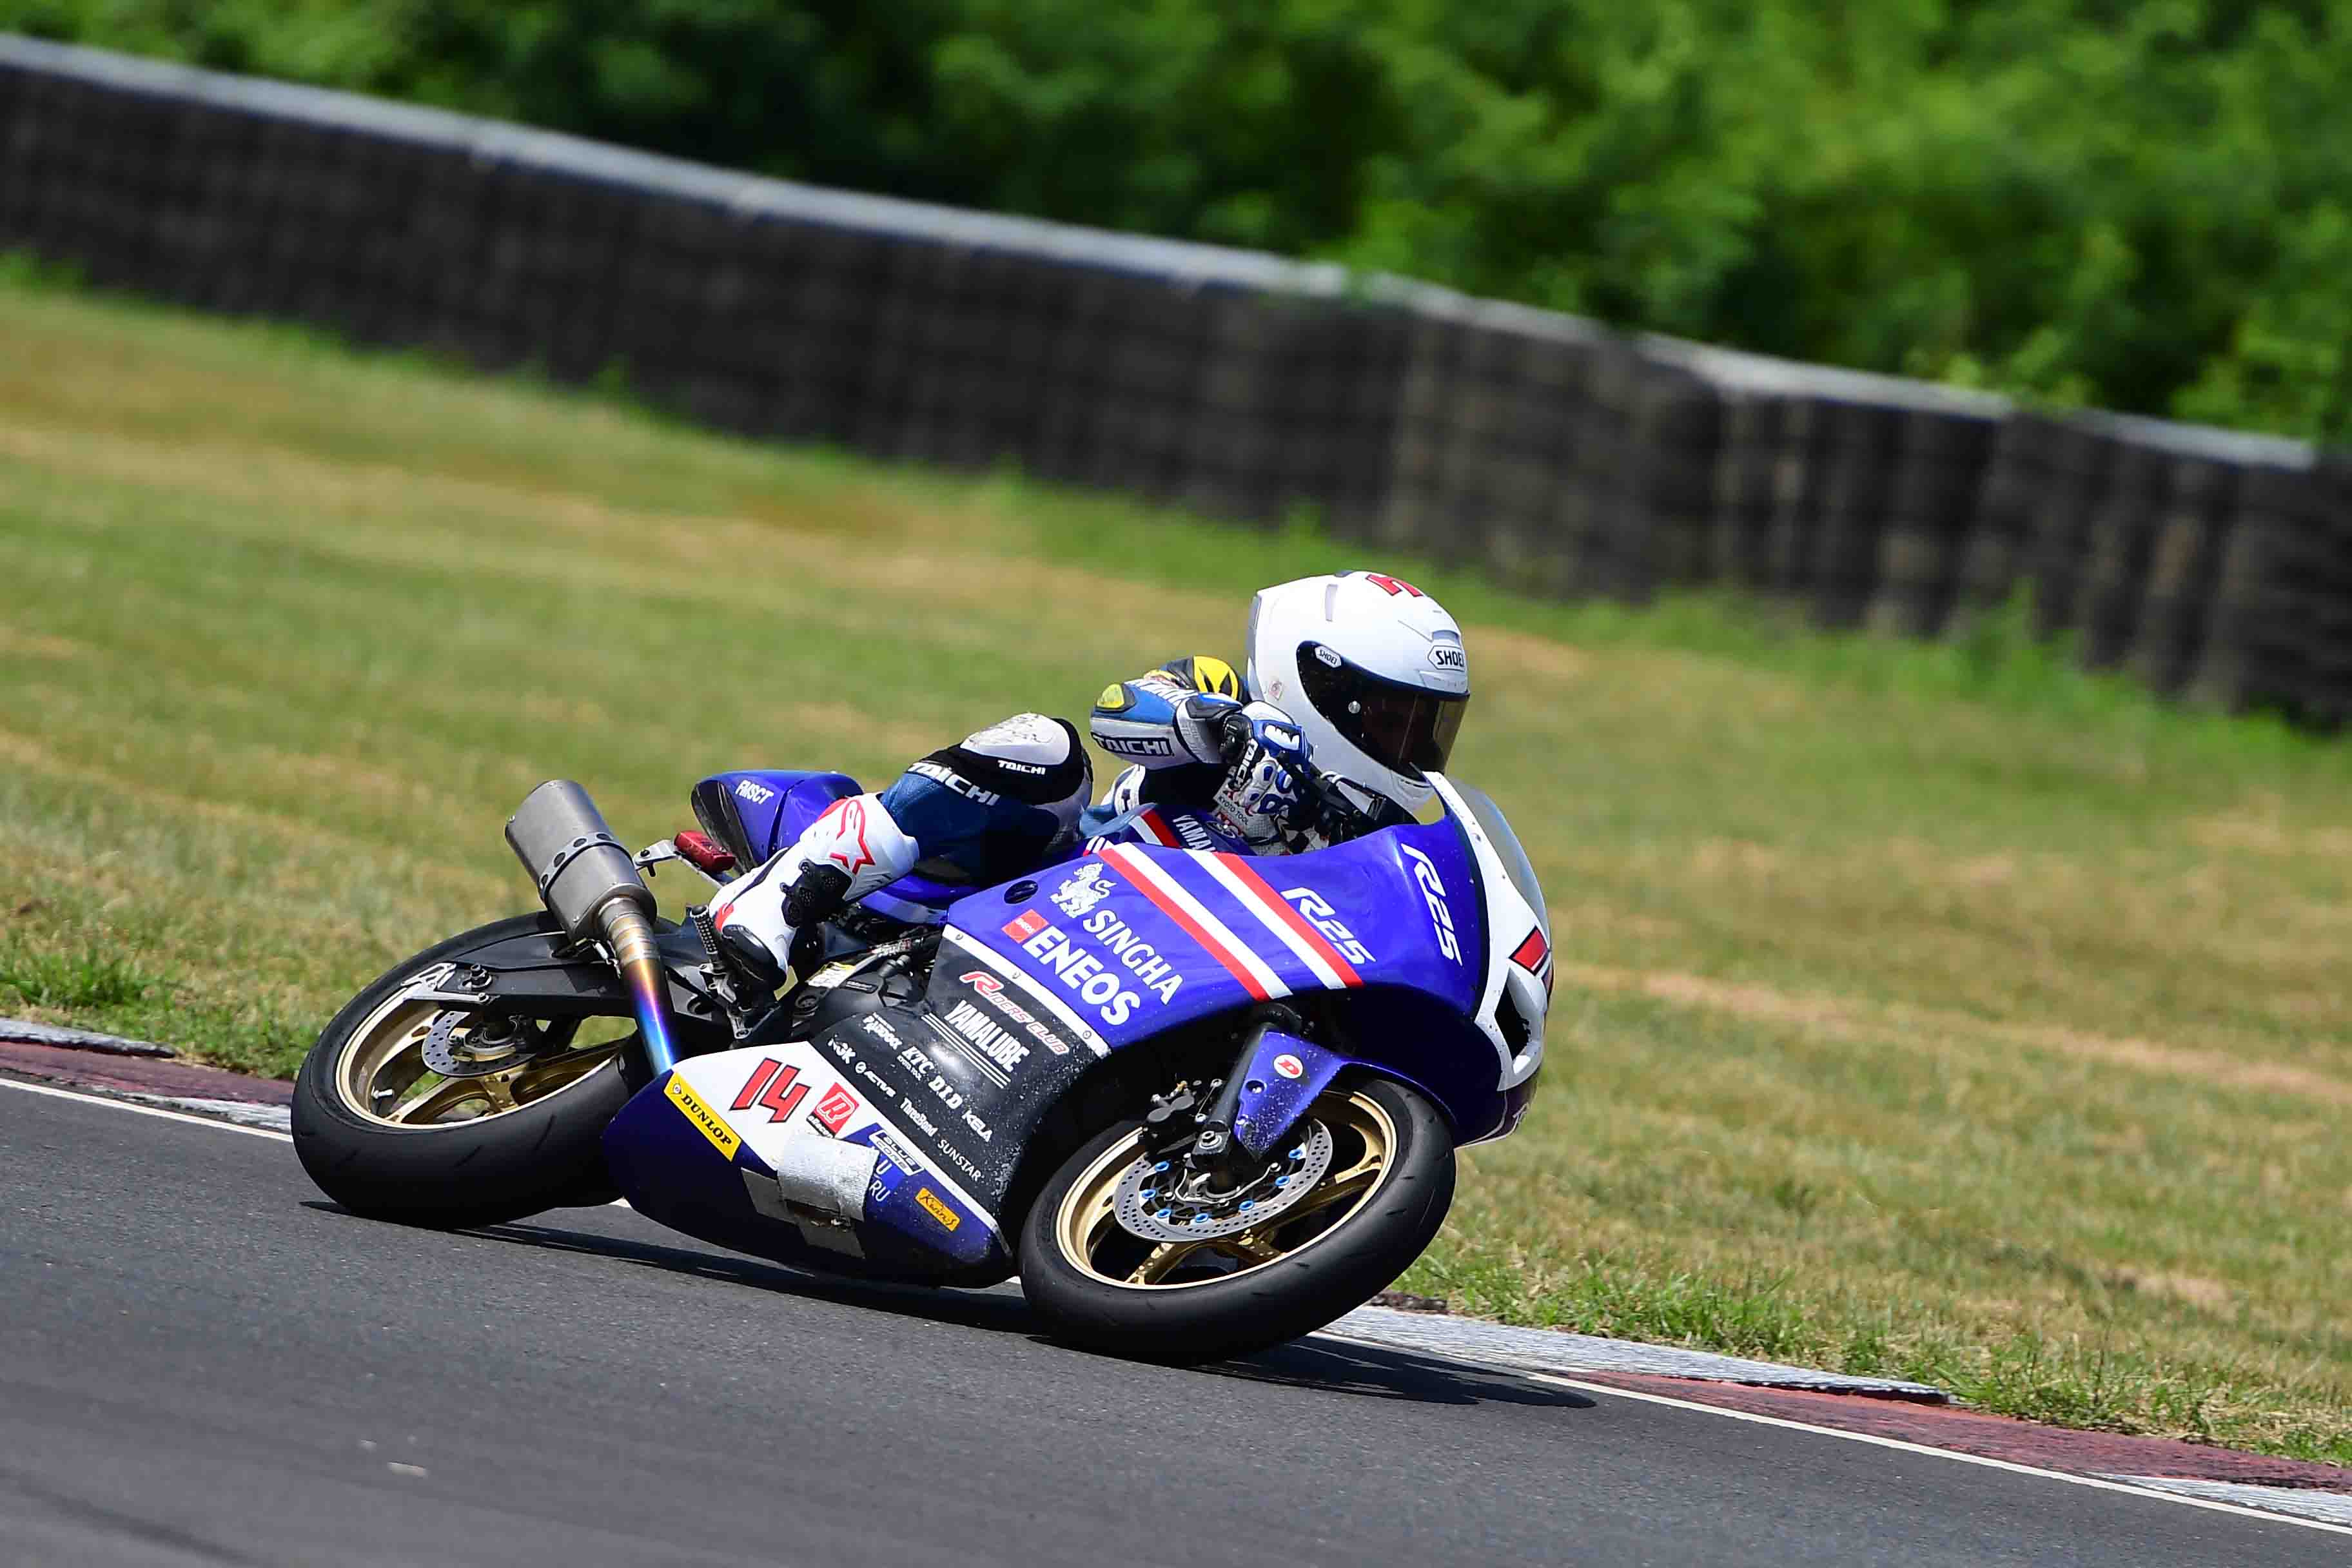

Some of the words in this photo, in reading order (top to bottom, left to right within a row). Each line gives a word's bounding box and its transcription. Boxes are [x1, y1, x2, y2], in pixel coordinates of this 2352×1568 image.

[1318, 649, 1338, 665] SHOEI
[997, 760, 1046, 775] TAICHI
[1091, 732, 1171, 756] TAICHI
[907, 761, 1000, 805] TAICHI
[1282, 887, 1375, 965] R25
[1401, 844, 1462, 966] R25
[1023, 925, 1141, 1025] ENEOS
[1083, 909, 1184, 1005] SINGHA
[943, 1000, 1030, 1072] YAMALUBE
[959, 971, 1034, 1022] RIDERS
[1026, 1018, 1070, 1055] CLUB
[902, 1046, 935, 1074] KTC
[729, 1057, 811, 1123] 14
[681, 1093, 732, 1144] DUNLOP
[900, 1097, 938, 1137] ThreeBond
[881, 1137, 916, 1166] BLUE
[937, 1139, 981, 1182] SUNSTAR
